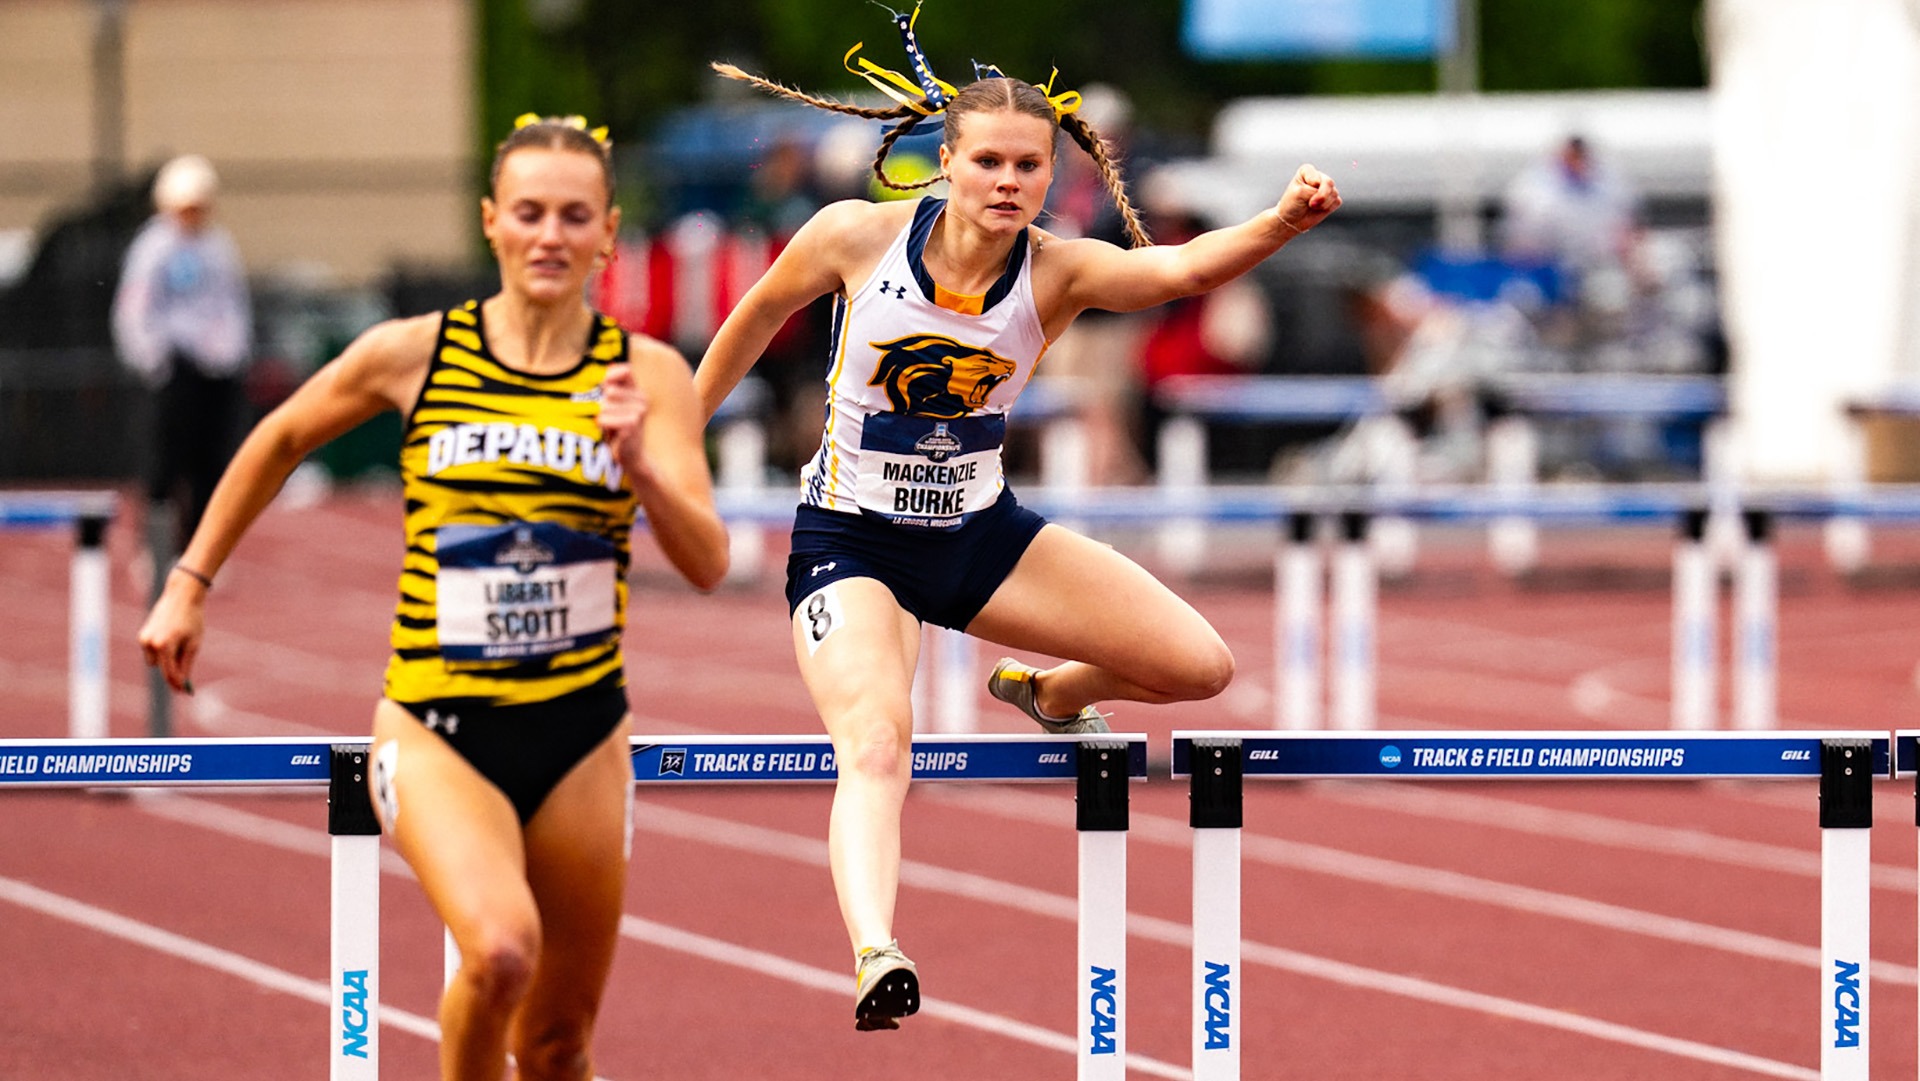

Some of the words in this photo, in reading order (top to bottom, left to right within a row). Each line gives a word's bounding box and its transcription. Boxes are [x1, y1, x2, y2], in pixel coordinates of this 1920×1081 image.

[427, 422, 623, 492] DEPAUW
[883, 461, 977, 485] MACKENZIE
[893, 487, 965, 514] BURKE
[484, 578, 567, 605] LIBERTY
[486, 607, 569, 641] SCOTT
[808, 593, 832, 642] 8
[0, 755, 39, 774] IELD
[42, 754, 192, 773] CHAMPIONSHIPS
[290, 755, 321, 765] GILL
[694, 753, 751, 772] TRACK
[752, 754, 765, 772] &
[768, 753, 816, 772] FIELD
[1038, 753, 1068, 764] GILL
[1249, 750, 1279, 760] GILL
[1413, 748, 1469, 767] TRACK
[1470, 748, 1484, 767] &
[1486, 748, 1535, 767] FIELD
[1538, 748, 1685, 767] CHAMPIONSHIPS
[1781, 750, 1811, 761] GILL
[342, 969, 369, 1060] NCAA
[1090, 965, 1116, 1055] NCAA
[1204, 960, 1230, 1050] NCAA
[1834, 959, 1860, 1048] NCAA
